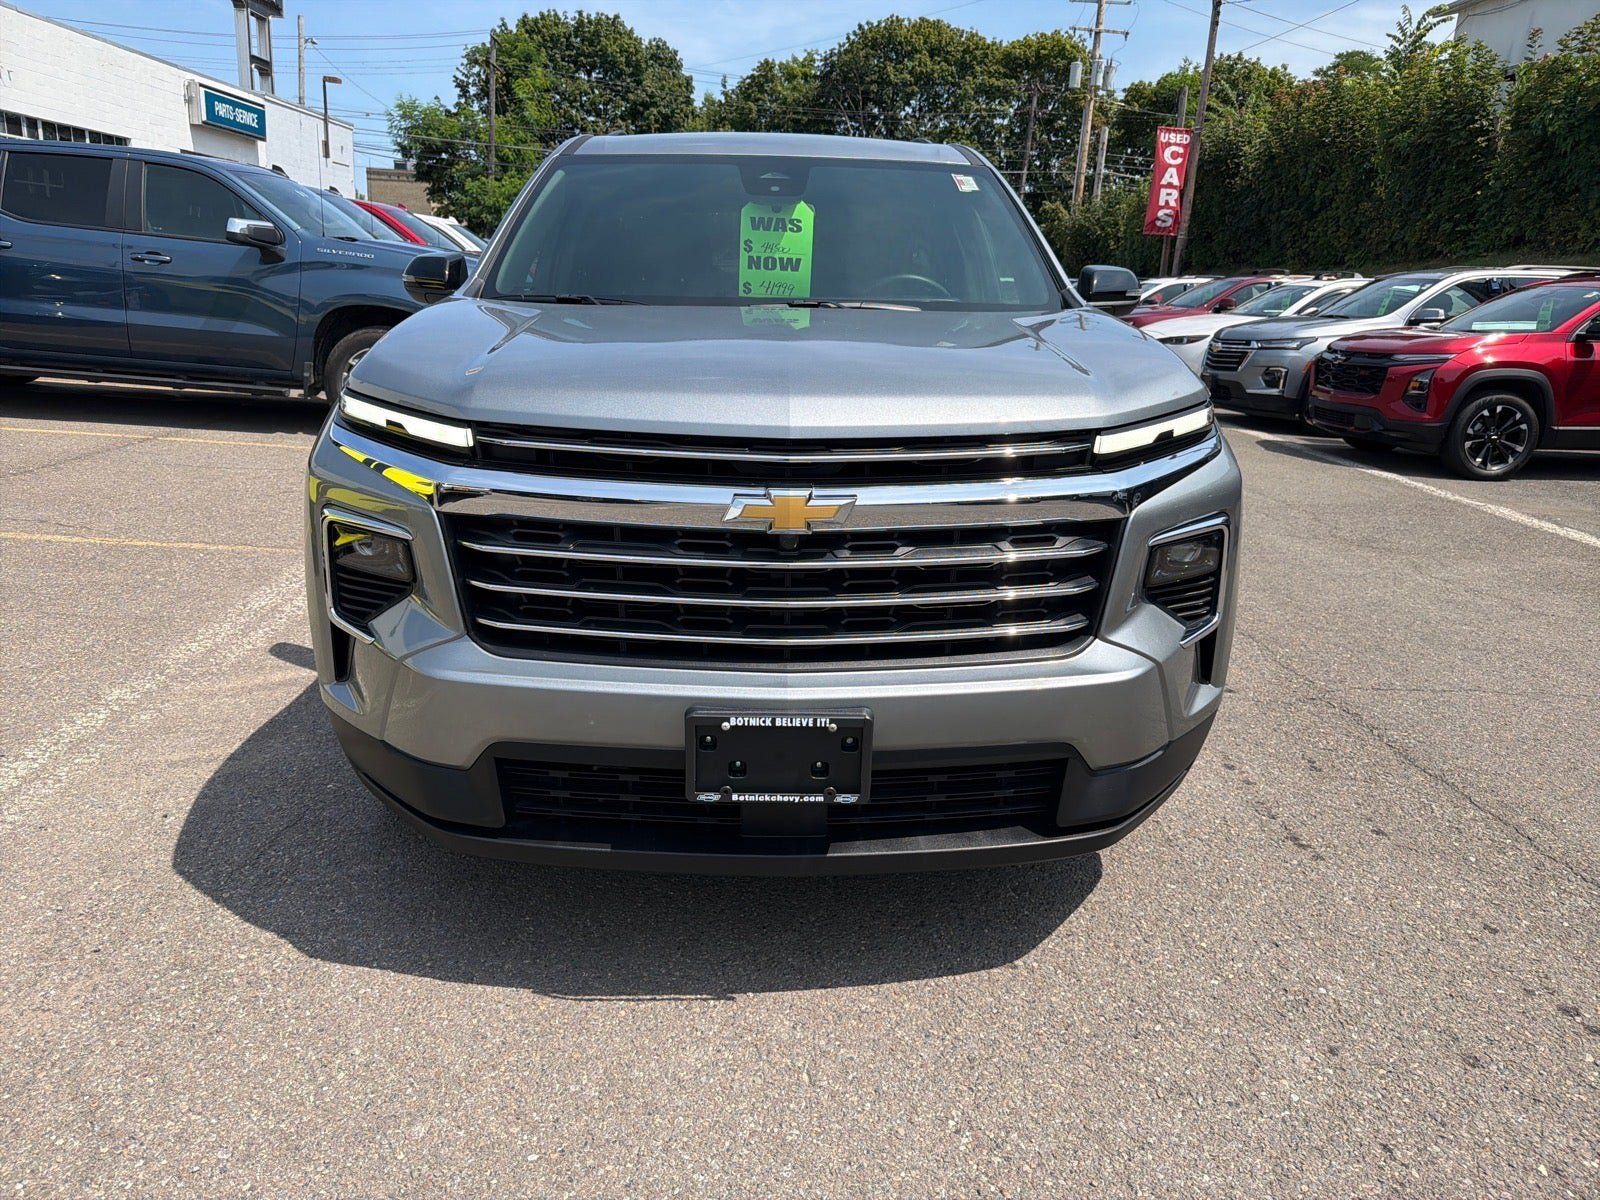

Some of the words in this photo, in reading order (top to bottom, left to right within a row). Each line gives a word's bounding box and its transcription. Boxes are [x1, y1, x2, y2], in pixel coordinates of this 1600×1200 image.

[214, 101, 259, 128] PARTS-SERVICE
[1160, 132, 1190, 144] USED
[1154, 145, 1185, 228] CARS
[749, 216, 803, 233] WAS
[316, 247, 375, 259] SILVERADO
[743, 238, 753, 254] $
[747, 255, 802, 272] NOW
[742, 281, 752, 295] $
[759, 280, 796, 297] 41999
[729, 717, 772, 727] BOTNICK
[775, 717, 814, 727] BELIEVE
[816, 717, 830, 728] IT!
[731, 794, 824, 803] Botnickchevy.com
